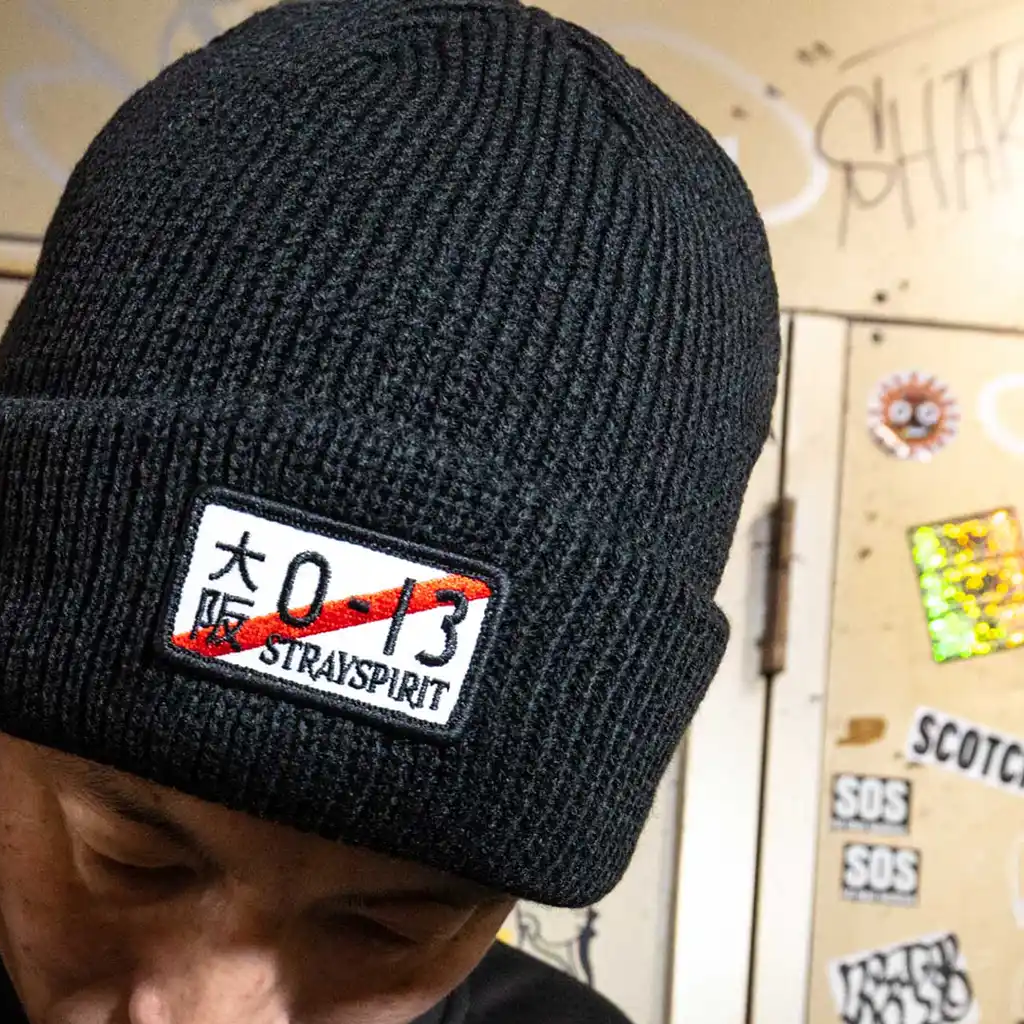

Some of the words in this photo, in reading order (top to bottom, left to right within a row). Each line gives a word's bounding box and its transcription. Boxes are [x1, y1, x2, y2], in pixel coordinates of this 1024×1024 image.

[192, 530, 266, 652] 大阪
[258, 633, 451, 712] STRAYSPIRIT
[912, 714, 1024, 789] SCOTC
[834, 775, 908, 822] SOS
[844, 844, 917, 892] SOS
